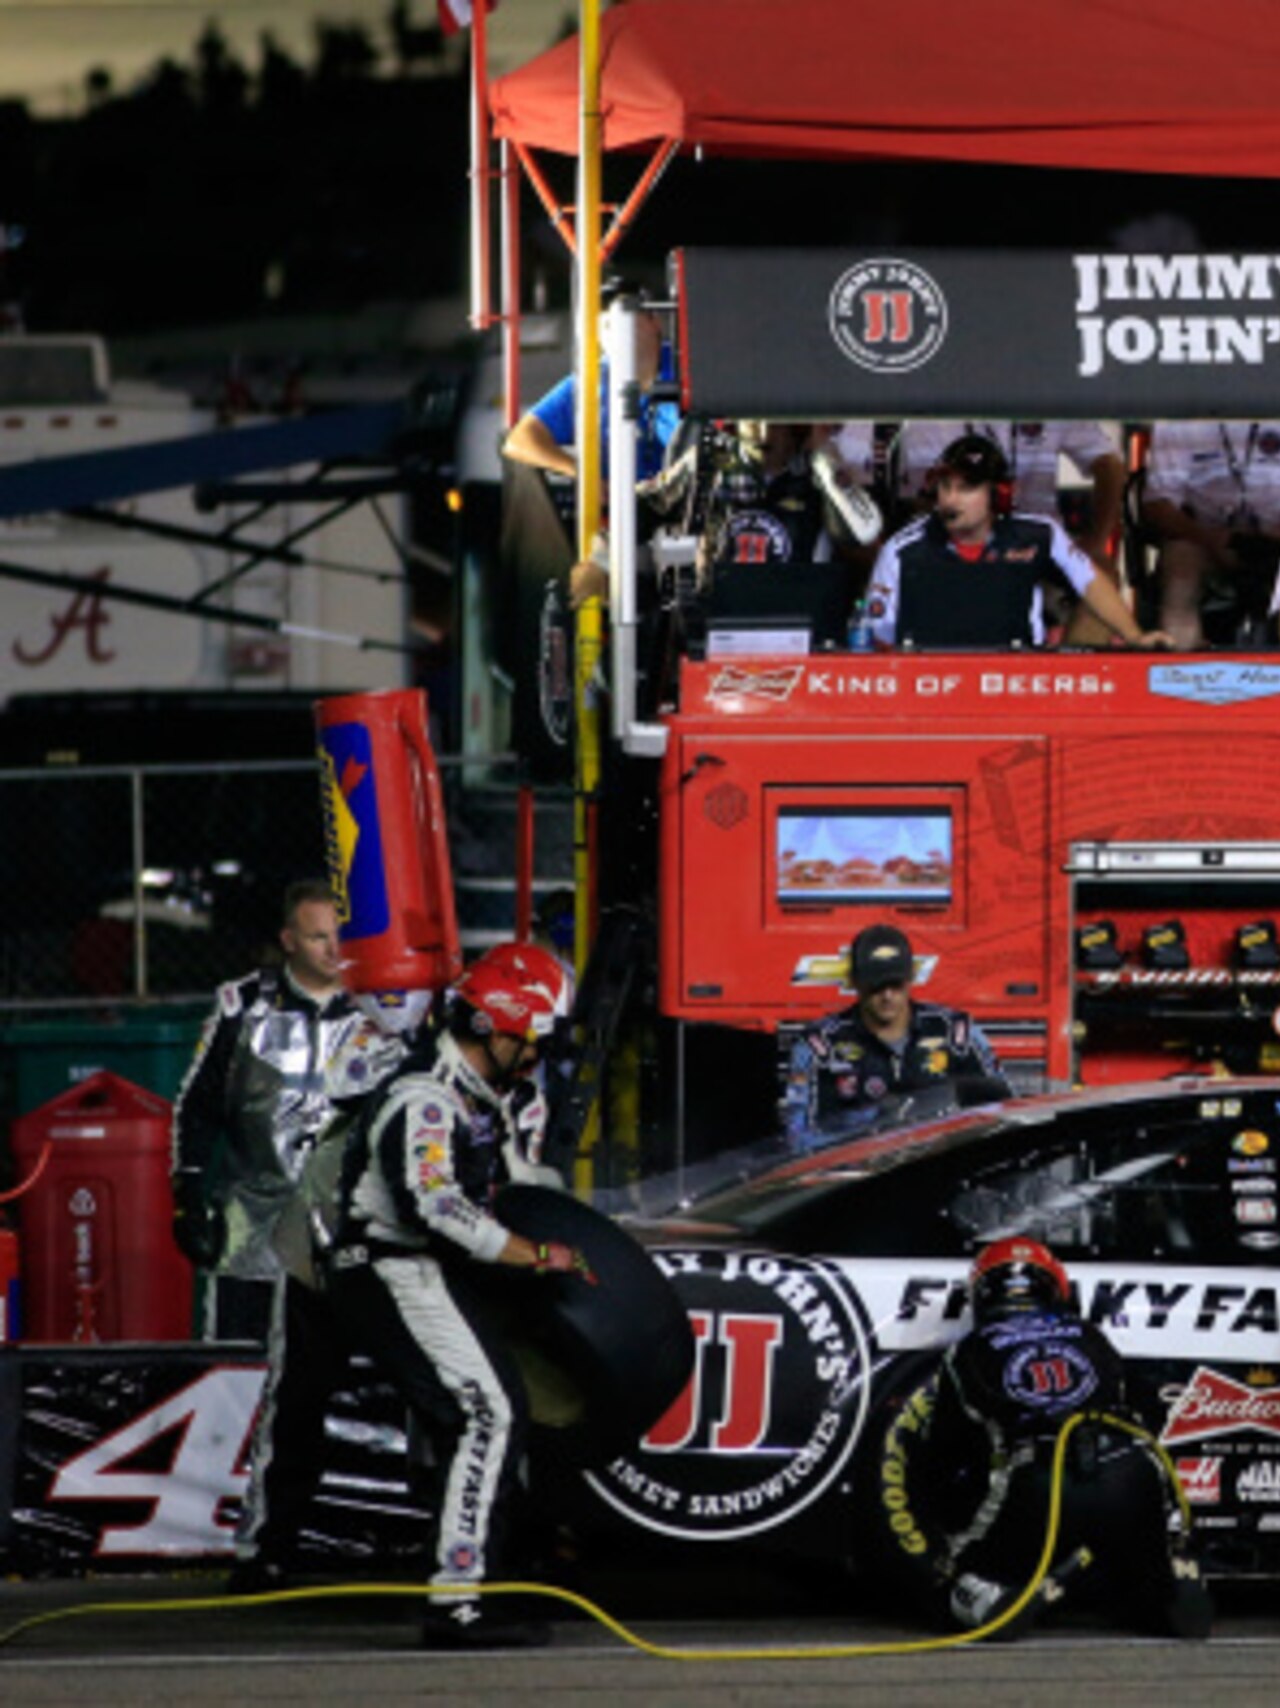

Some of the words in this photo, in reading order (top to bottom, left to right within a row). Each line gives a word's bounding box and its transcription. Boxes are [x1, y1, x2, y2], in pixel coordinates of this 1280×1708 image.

[862, 289, 913, 343] JJ
[914, 674, 962, 695] OF
[720, 1252, 850, 1382] JOHN'S
[45, 1362, 271, 1557] 4
